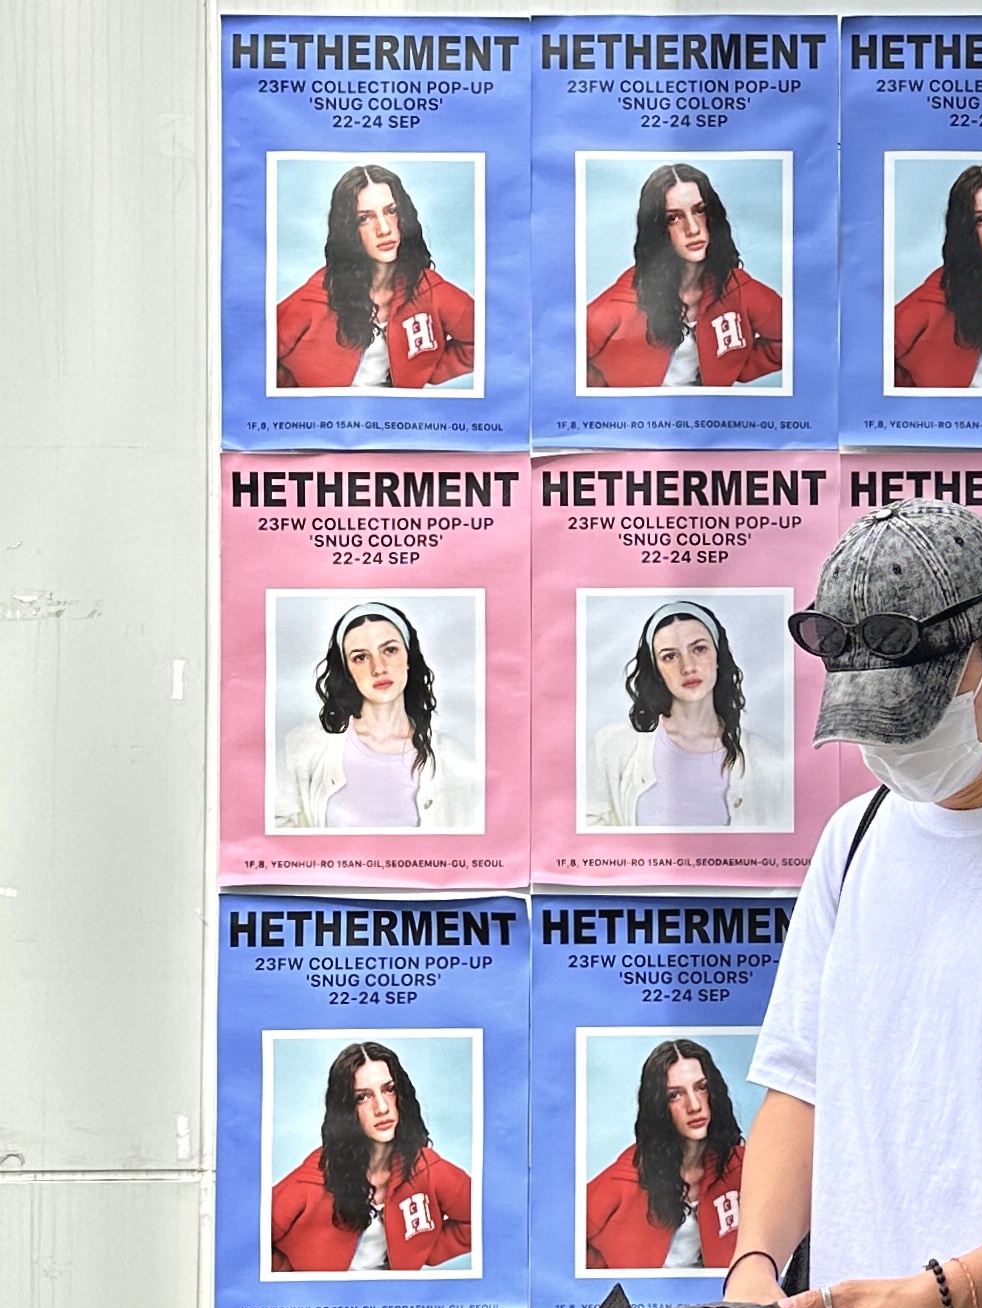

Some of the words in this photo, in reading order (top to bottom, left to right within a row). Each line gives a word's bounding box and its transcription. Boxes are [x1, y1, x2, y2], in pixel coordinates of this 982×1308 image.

[232, 33, 519, 71] HETHERMENT
[542, 33, 826, 70] HETHERMENT
[258, 79, 305, 93] 23FW
[311, 80, 421, 93] COLLECTION
[427, 81, 493, 94] POP-UP
[567, 79, 614, 93] 23FW
[620, 79, 728, 93] COLLECTION
[734, 79, 801, 93] POP-UP
[876, 79, 924, 92] 23FW
[309, 96, 362, 110] 'SNUG
[368, 97, 442, 111] COLORS'
[618, 96, 670, 110] 'SNUG
[676, 96, 750, 110] COLORS'
[927, 96, 980, 109] 'SNUG
[332, 115, 382, 128] 22-24
[388, 115, 420, 128] SEP
[640, 114, 691, 127] 22-24
[696, 114, 727, 127] SEP
[471, 423, 503, 431] SEOUL
[780, 420, 811, 429] SEOUL
[232, 471, 519, 507] HETHERMENT
[542, 470, 826, 506] HETHERMENT
[258, 517, 306, 531] 23FW
[311, 517, 421, 530] COLLECTION
[427, 517, 494, 530] POP-UP
[568, 516, 615, 530] 23FW
[620, 516, 729, 529] COLLECTION
[735, 515, 801, 529] POP-UP
[309, 534, 362, 547] 'SNUG
[368, 534, 442, 547] COLORS'
[618, 532, 671, 546] 'SNUG
[676, 532, 751, 546] COLORS'
[332, 551, 383, 564] 22-24
[388, 551, 420, 564] SEP
[641, 550, 691, 563] 22-24
[696, 550, 728, 563] SEP
[471, 859, 503, 867] SEOUL
[229, 910, 517, 948] HETHERMENT
[542, 907, 795, 944] HETHERMEN
[255, 957, 303, 971] 23FW
[309, 956, 419, 970] COLLECTION
[425, 956, 492, 969] POP-UP
[568, 954, 616, 968] 23FW
[621, 953, 734, 972] COLLECTION
[736, 953, 780, 968] POP-
[306, 973, 359, 987] 'SNUG
[365, 973, 440, 987] COLORS'
[619, 970, 672, 984] 'SNUG
[677, 970, 753, 984] COLORS'
[329, 991, 380, 1004] 22-24
[385, 991, 417, 1004] SEP
[642, 988, 692, 1002] 22-24
[698, 988, 730, 1002] SEP
